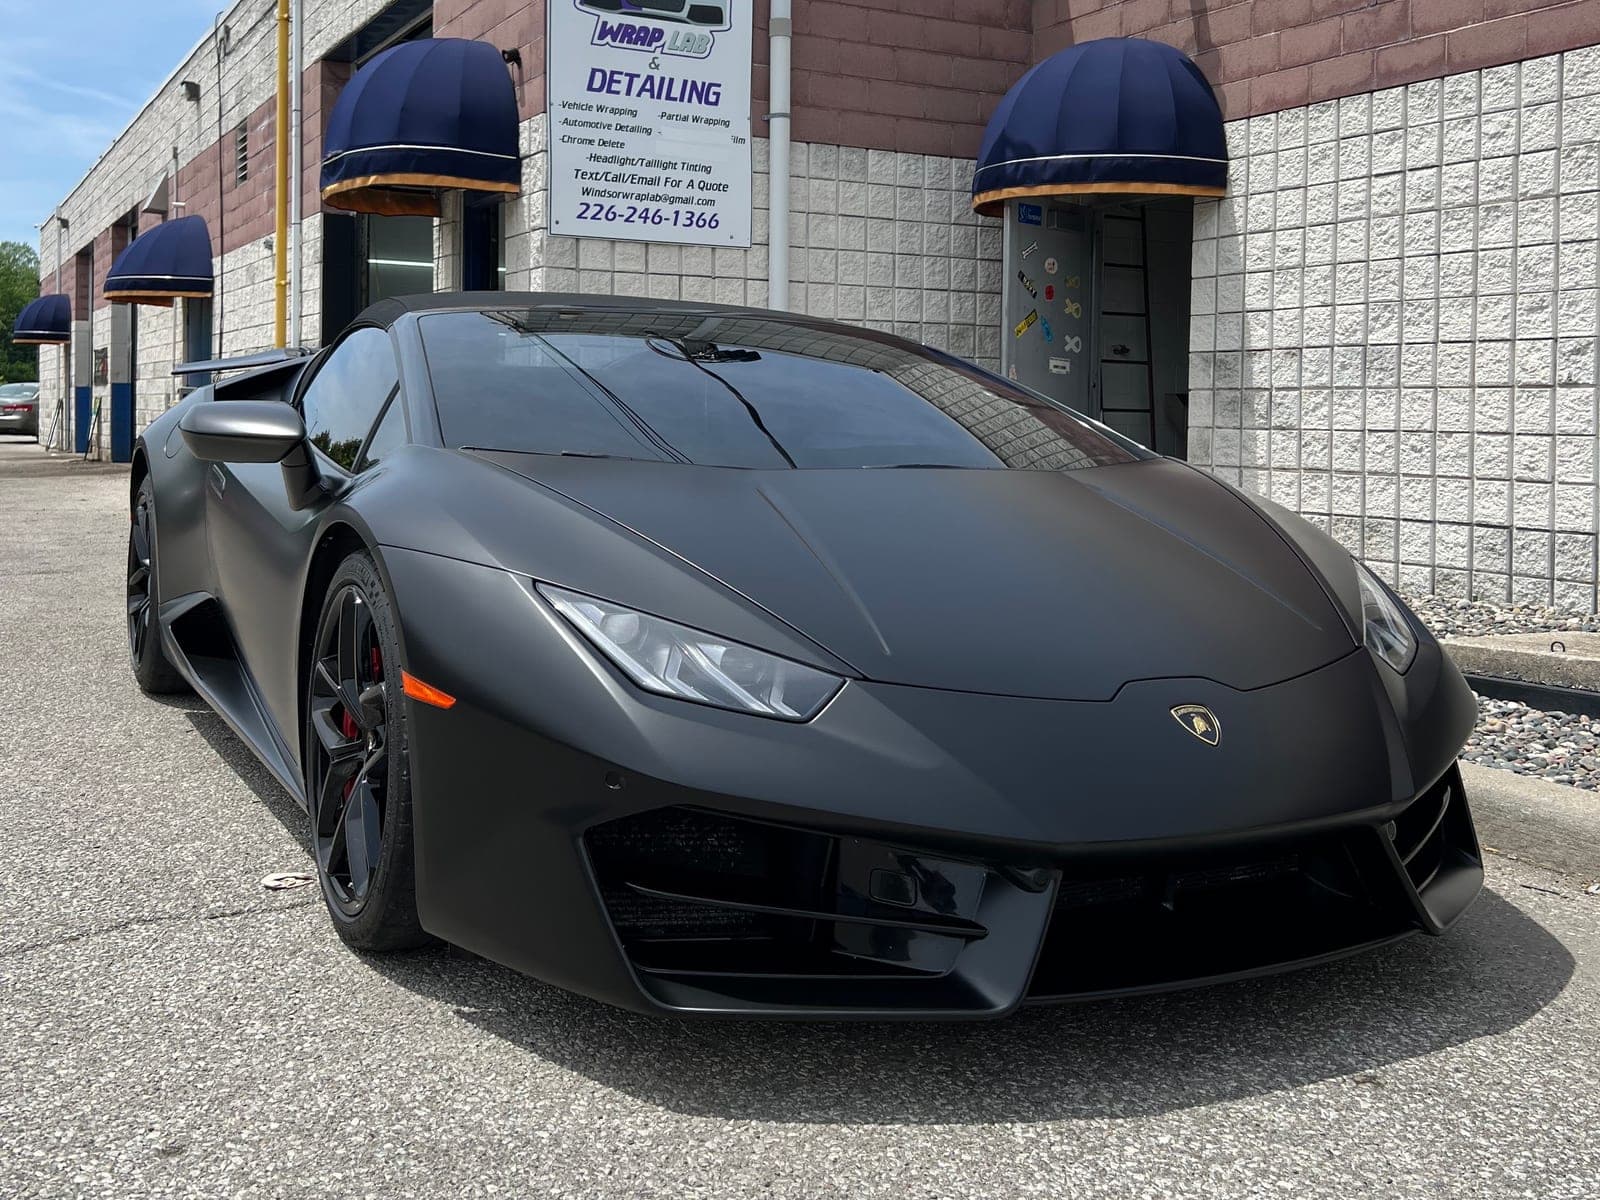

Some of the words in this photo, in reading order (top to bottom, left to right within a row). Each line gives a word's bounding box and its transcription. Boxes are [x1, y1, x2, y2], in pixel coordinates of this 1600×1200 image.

[597, 20, 665, 48] WRAP
[667, 31, 711, 54] LAB
[648, 56, 661, 71] &
[586, 67, 722, 107] DETAILING
[596, 104, 638, 118] Wrapping
[614, 122, 653, 136] Detailing
[691, 115, 731, 128] Wrapping
[597, 138, 626, 149] Delete
[681, 161, 713, 175] Tinting
[573, 168, 661, 188] Text/Call/Email
[664, 176, 683, 189] For
[686, 179, 695, 190] A
[697, 179, 730, 193] Quote
[581, 186, 716, 207] Windsorwraplab@gmail.com
[575, 202, 720, 230] 226-246-1366
